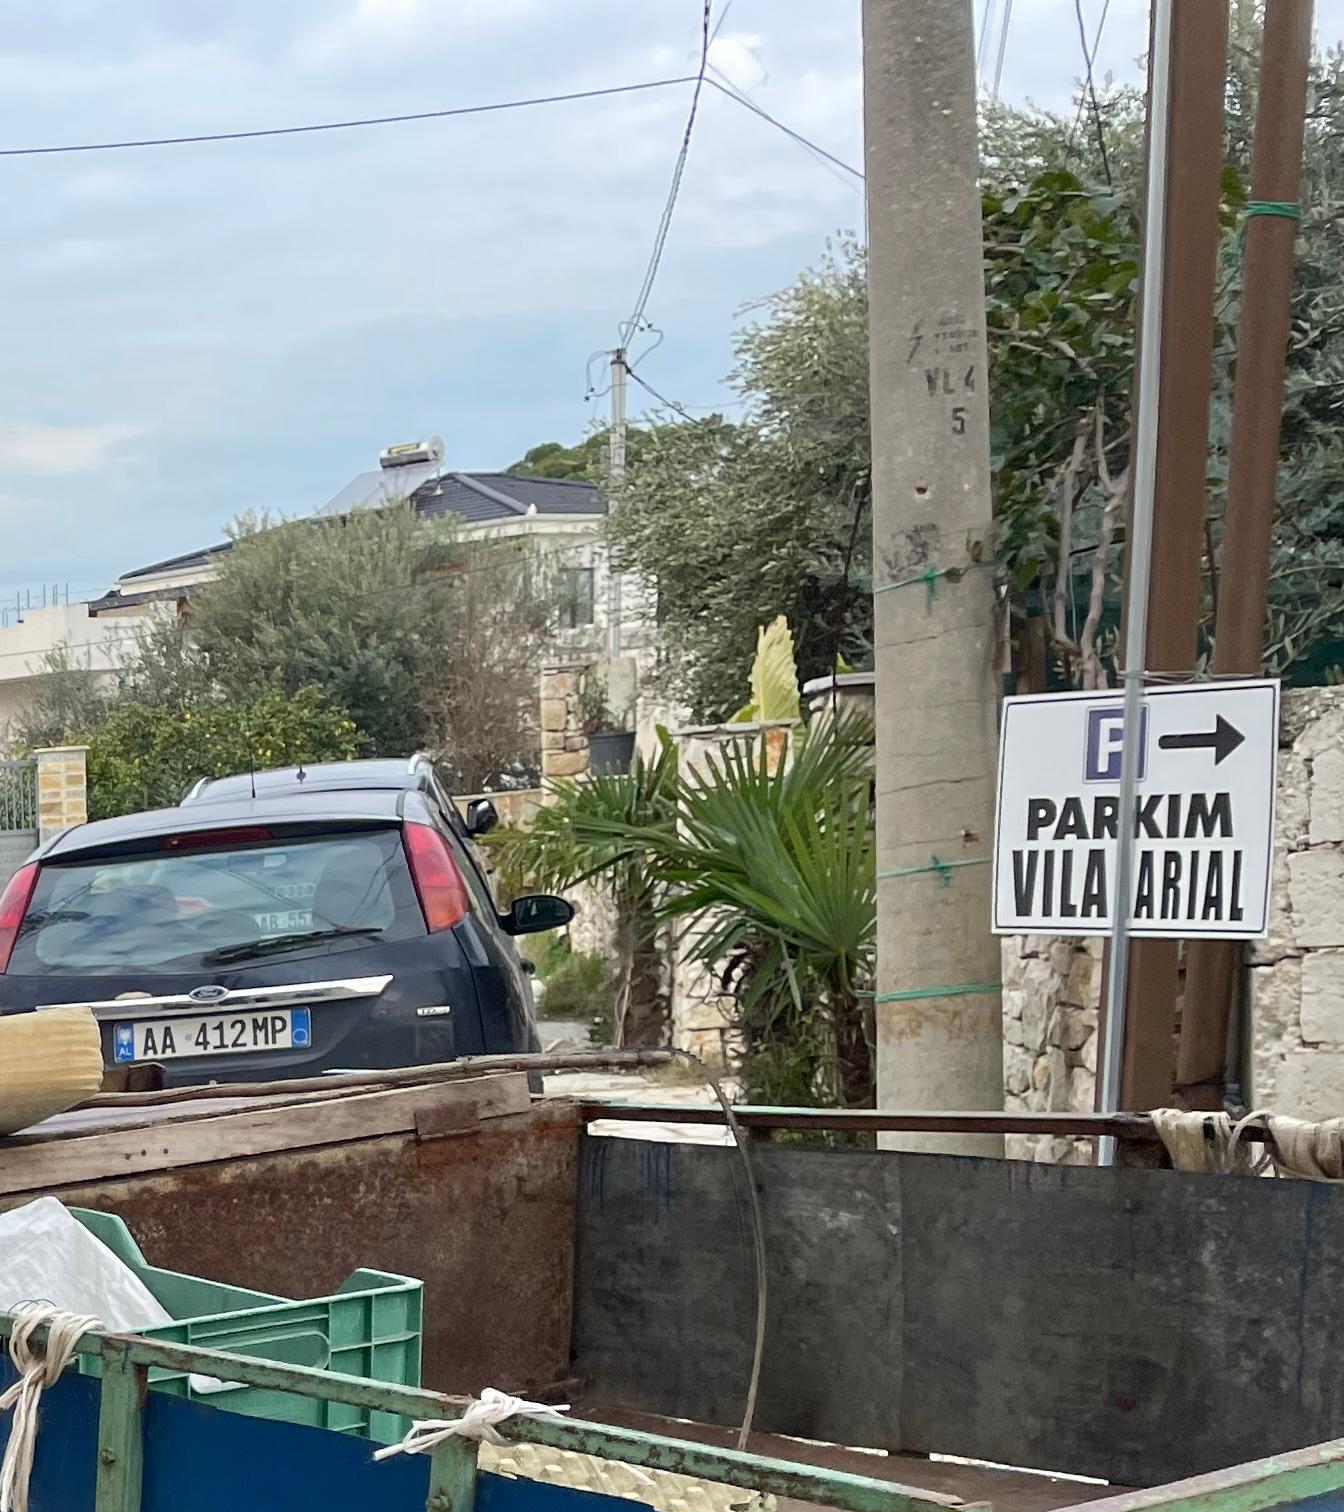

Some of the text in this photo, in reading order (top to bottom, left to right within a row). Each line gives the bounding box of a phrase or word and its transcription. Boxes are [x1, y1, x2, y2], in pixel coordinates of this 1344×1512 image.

[952, 407, 967, 435] 5
[1026, 792, 1234, 841] PARKIM
[1012, 848, 1245, 922] VILA ARIAL
[118, 1047, 133, 1057] AL
[142, 1026, 177, 1057] AA
